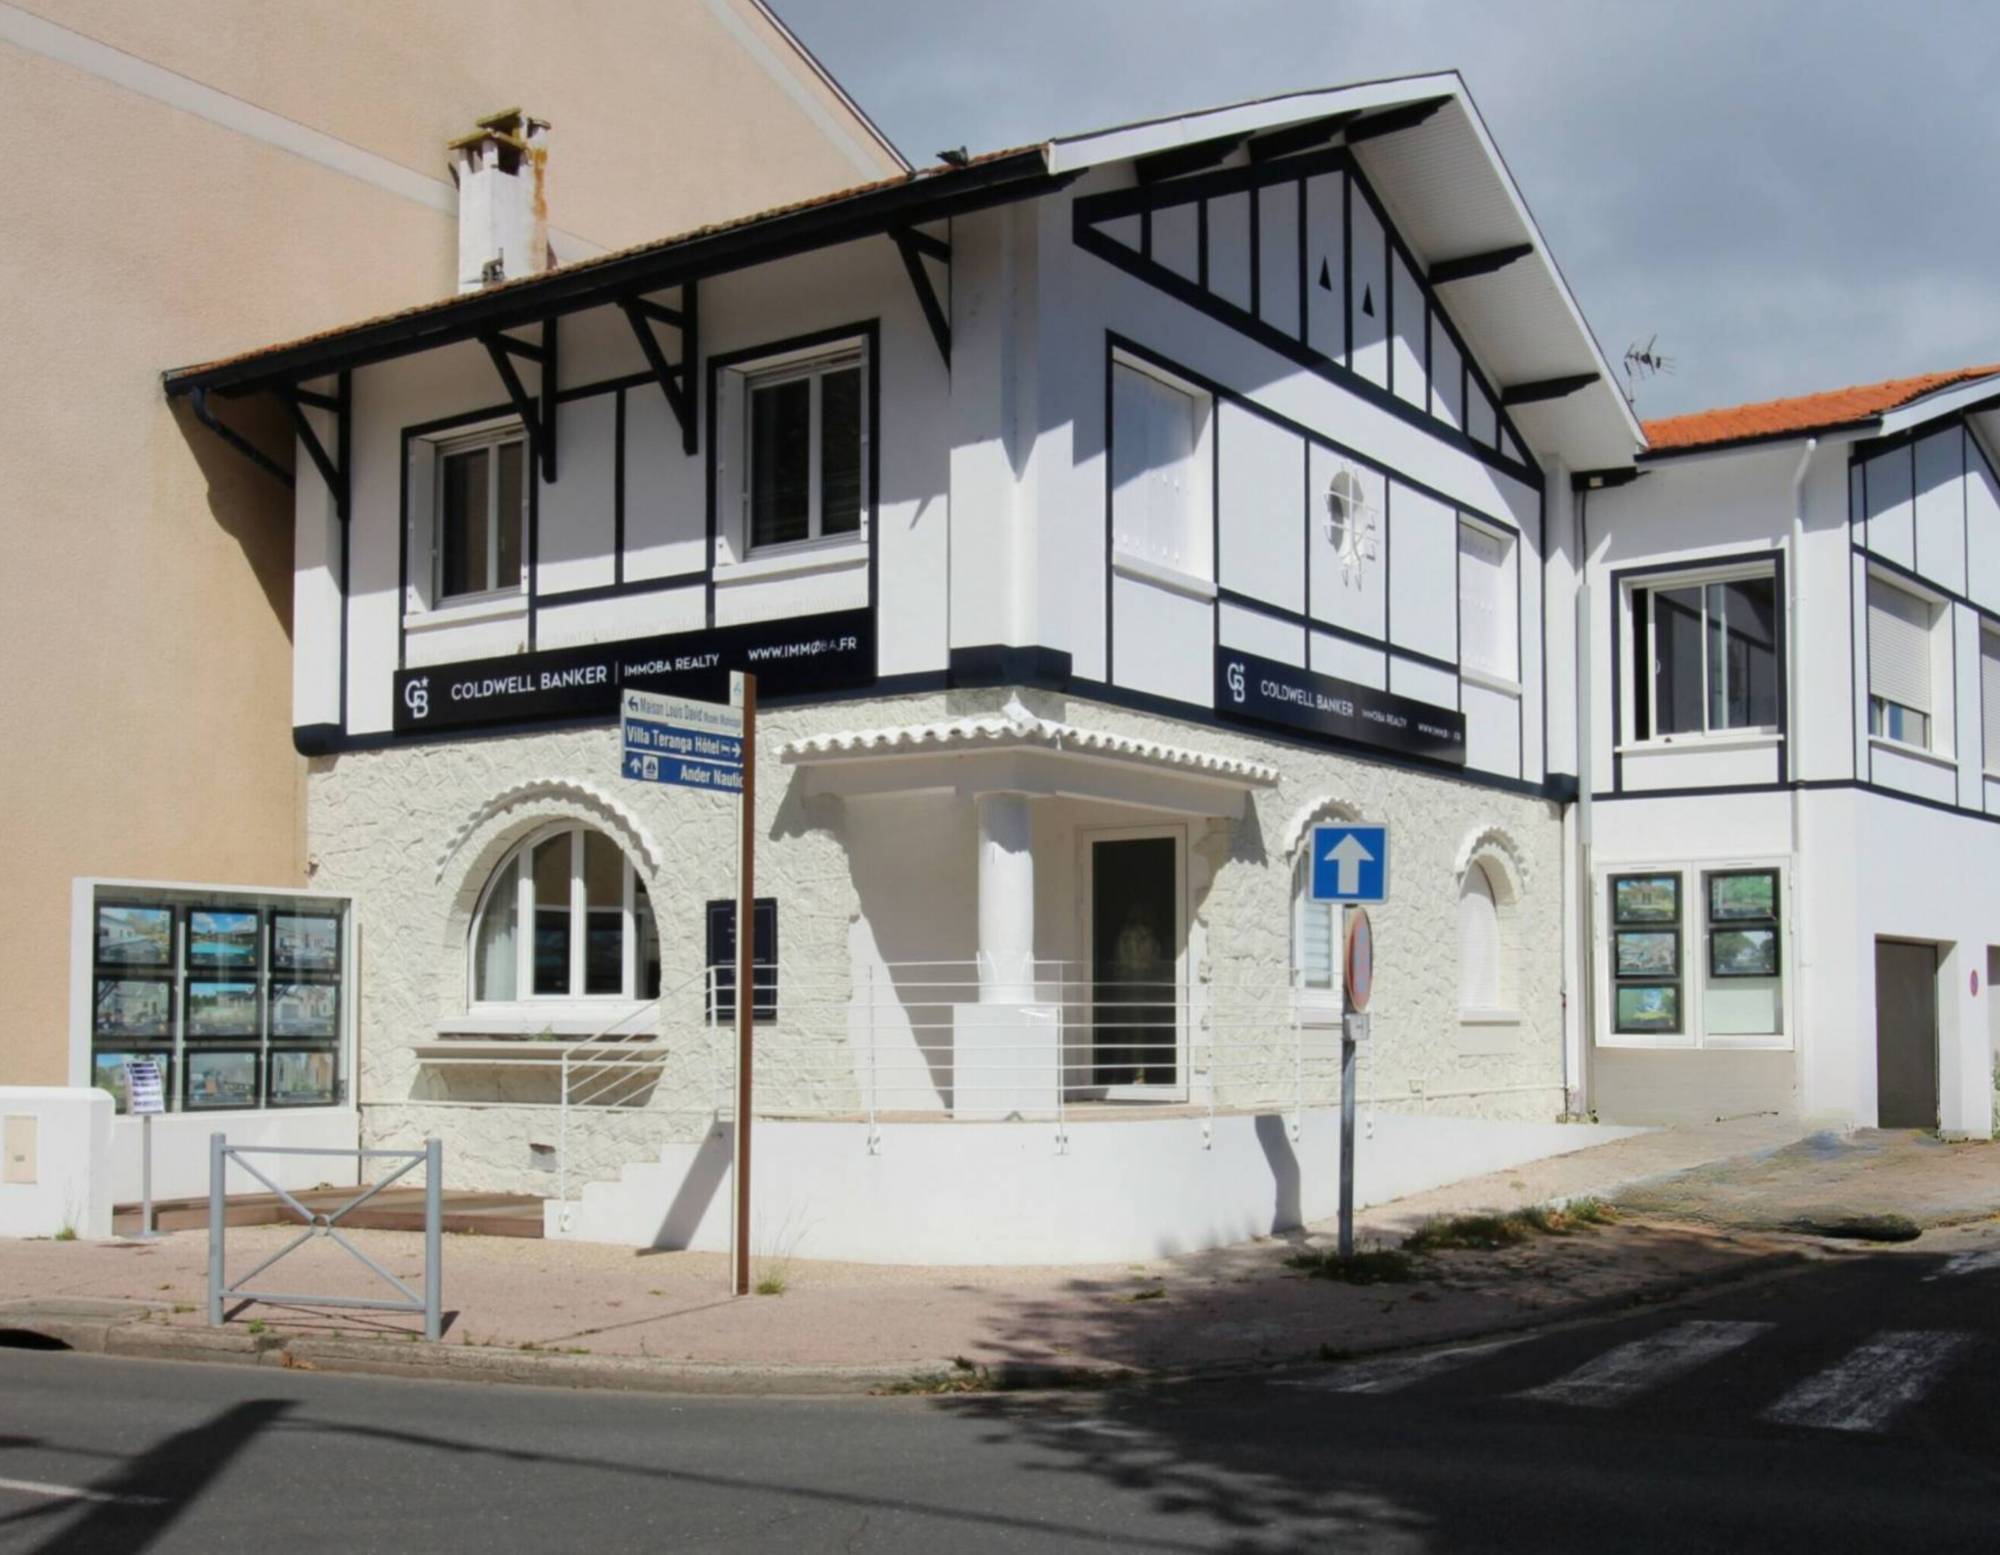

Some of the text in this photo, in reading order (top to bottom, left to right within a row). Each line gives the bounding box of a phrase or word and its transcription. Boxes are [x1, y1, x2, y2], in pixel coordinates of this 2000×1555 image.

[451, 674, 535, 700] COLDWELL
[540, 665, 607, 690] BANKER
[624, 660, 672, 677] IMMOBA
[675, 653, 720, 671] REALTY
[1261, 680, 1315, 708] COLDWELL
[1316, 693, 1354, 717] BANKER
[626, 725, 720, 754] Villa Teranga Hôtel
[681, 763, 711, 783] Ander
